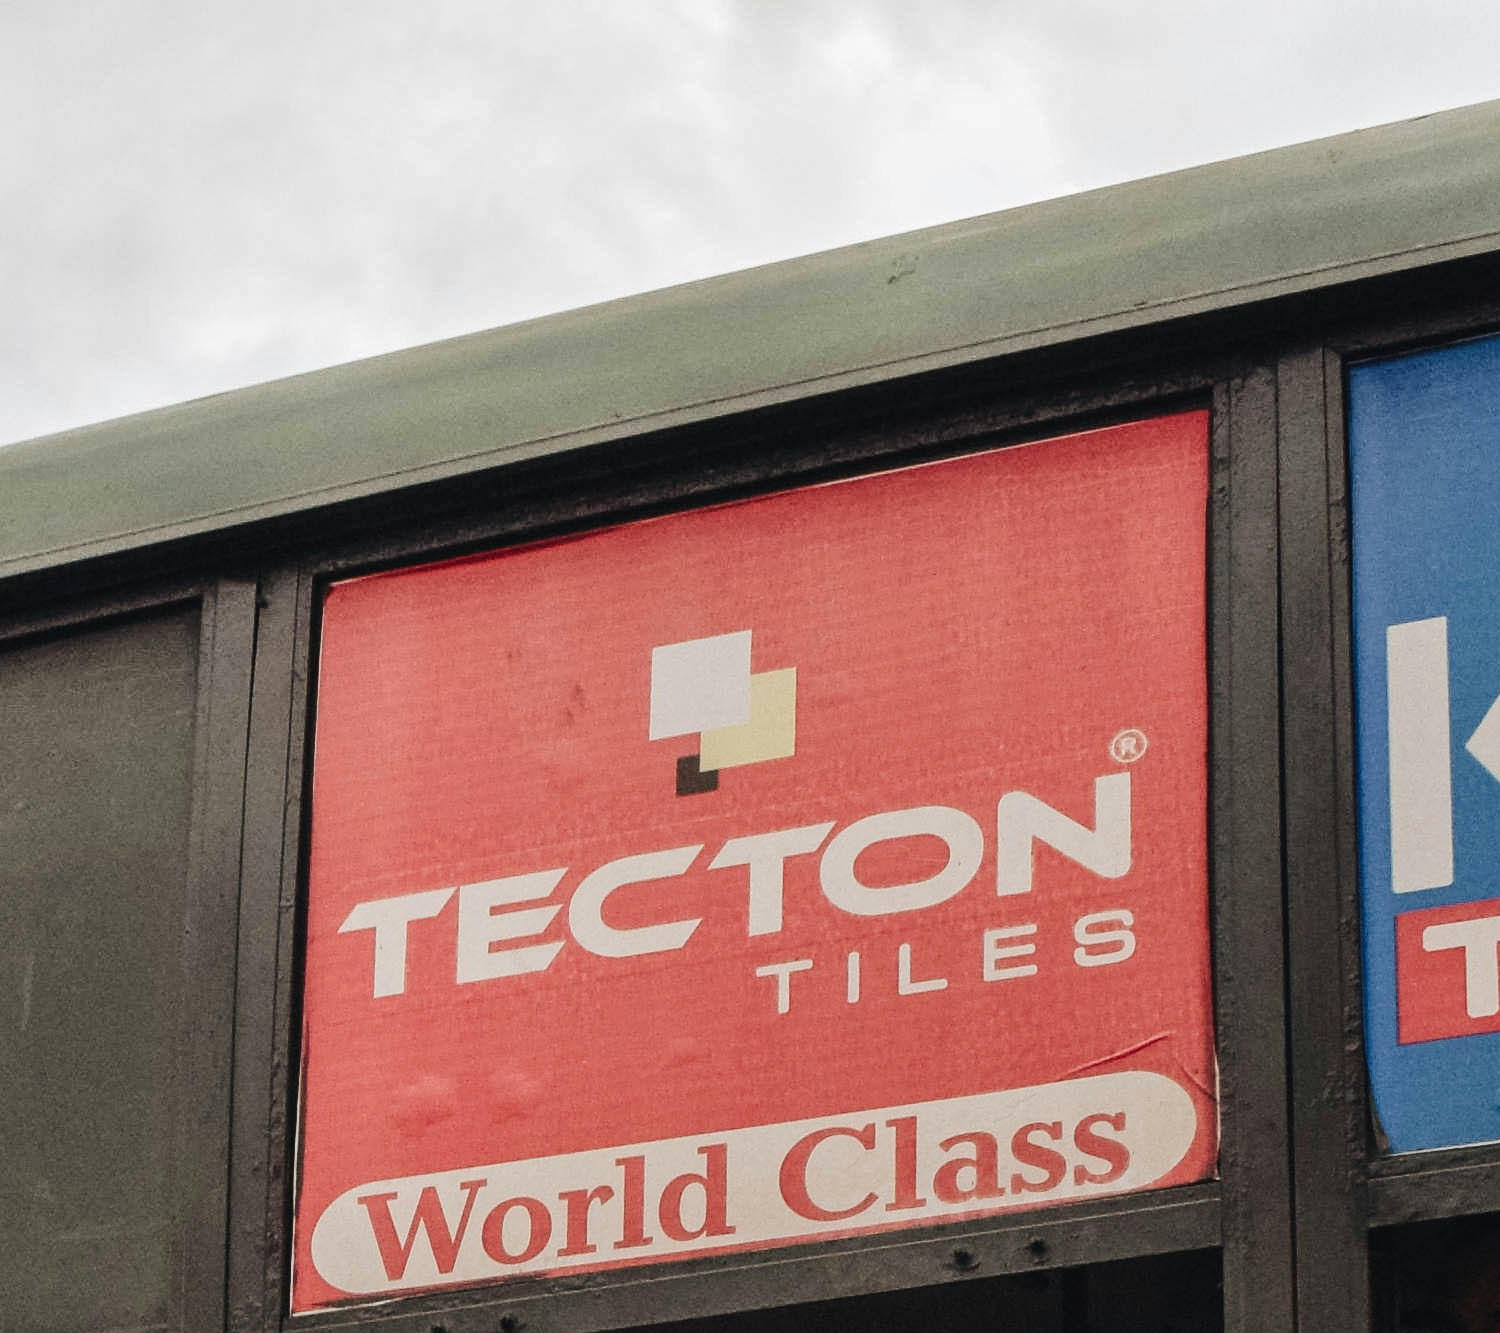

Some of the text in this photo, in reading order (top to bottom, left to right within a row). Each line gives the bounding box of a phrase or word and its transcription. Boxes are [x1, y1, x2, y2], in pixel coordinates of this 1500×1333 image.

[337, 770, 1133, 999] TECTON
[755, 908, 1137, 1015] TILES
[357, 1110, 1130, 1282] World Class
